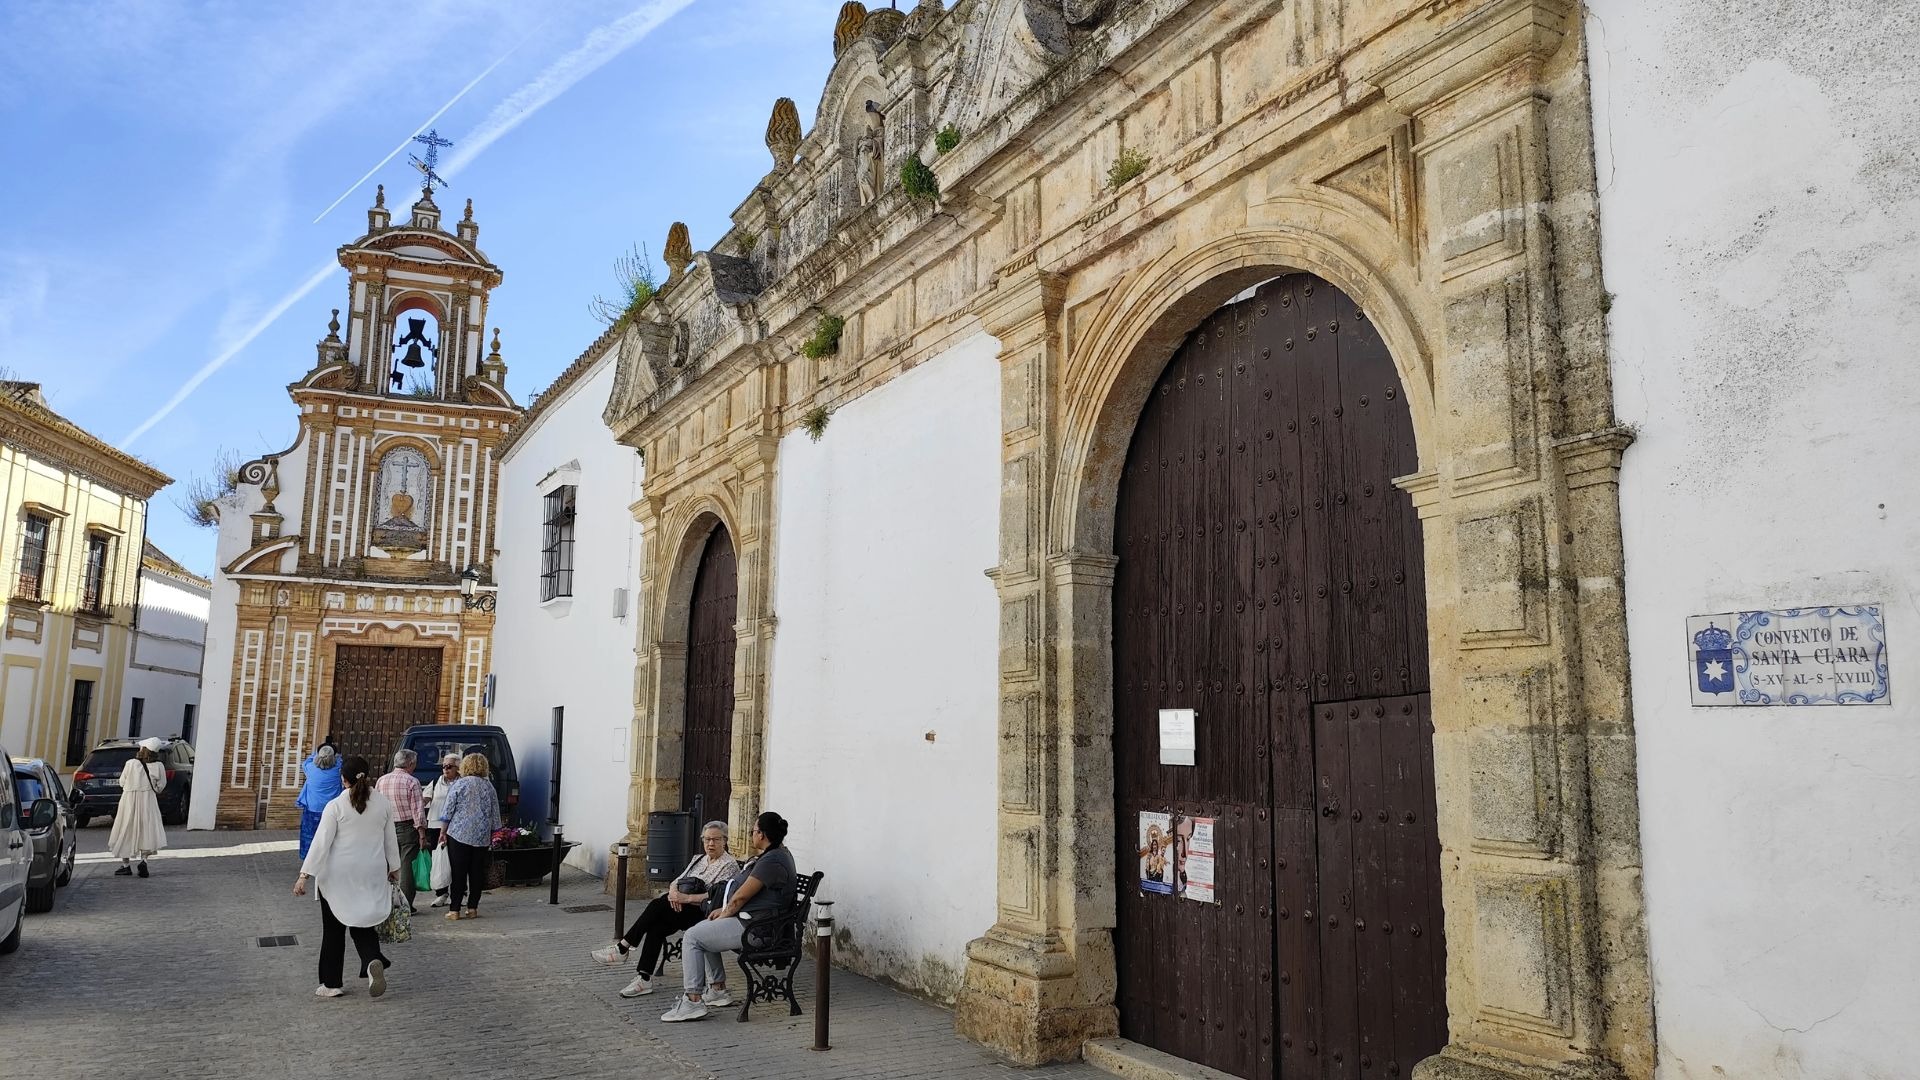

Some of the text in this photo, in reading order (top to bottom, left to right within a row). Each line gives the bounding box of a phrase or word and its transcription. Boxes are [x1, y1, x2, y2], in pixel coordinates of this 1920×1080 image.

[1754, 626, 1859, 647] CONVENTO DE
[1751, 647, 1871, 665] SANTA CLARA
